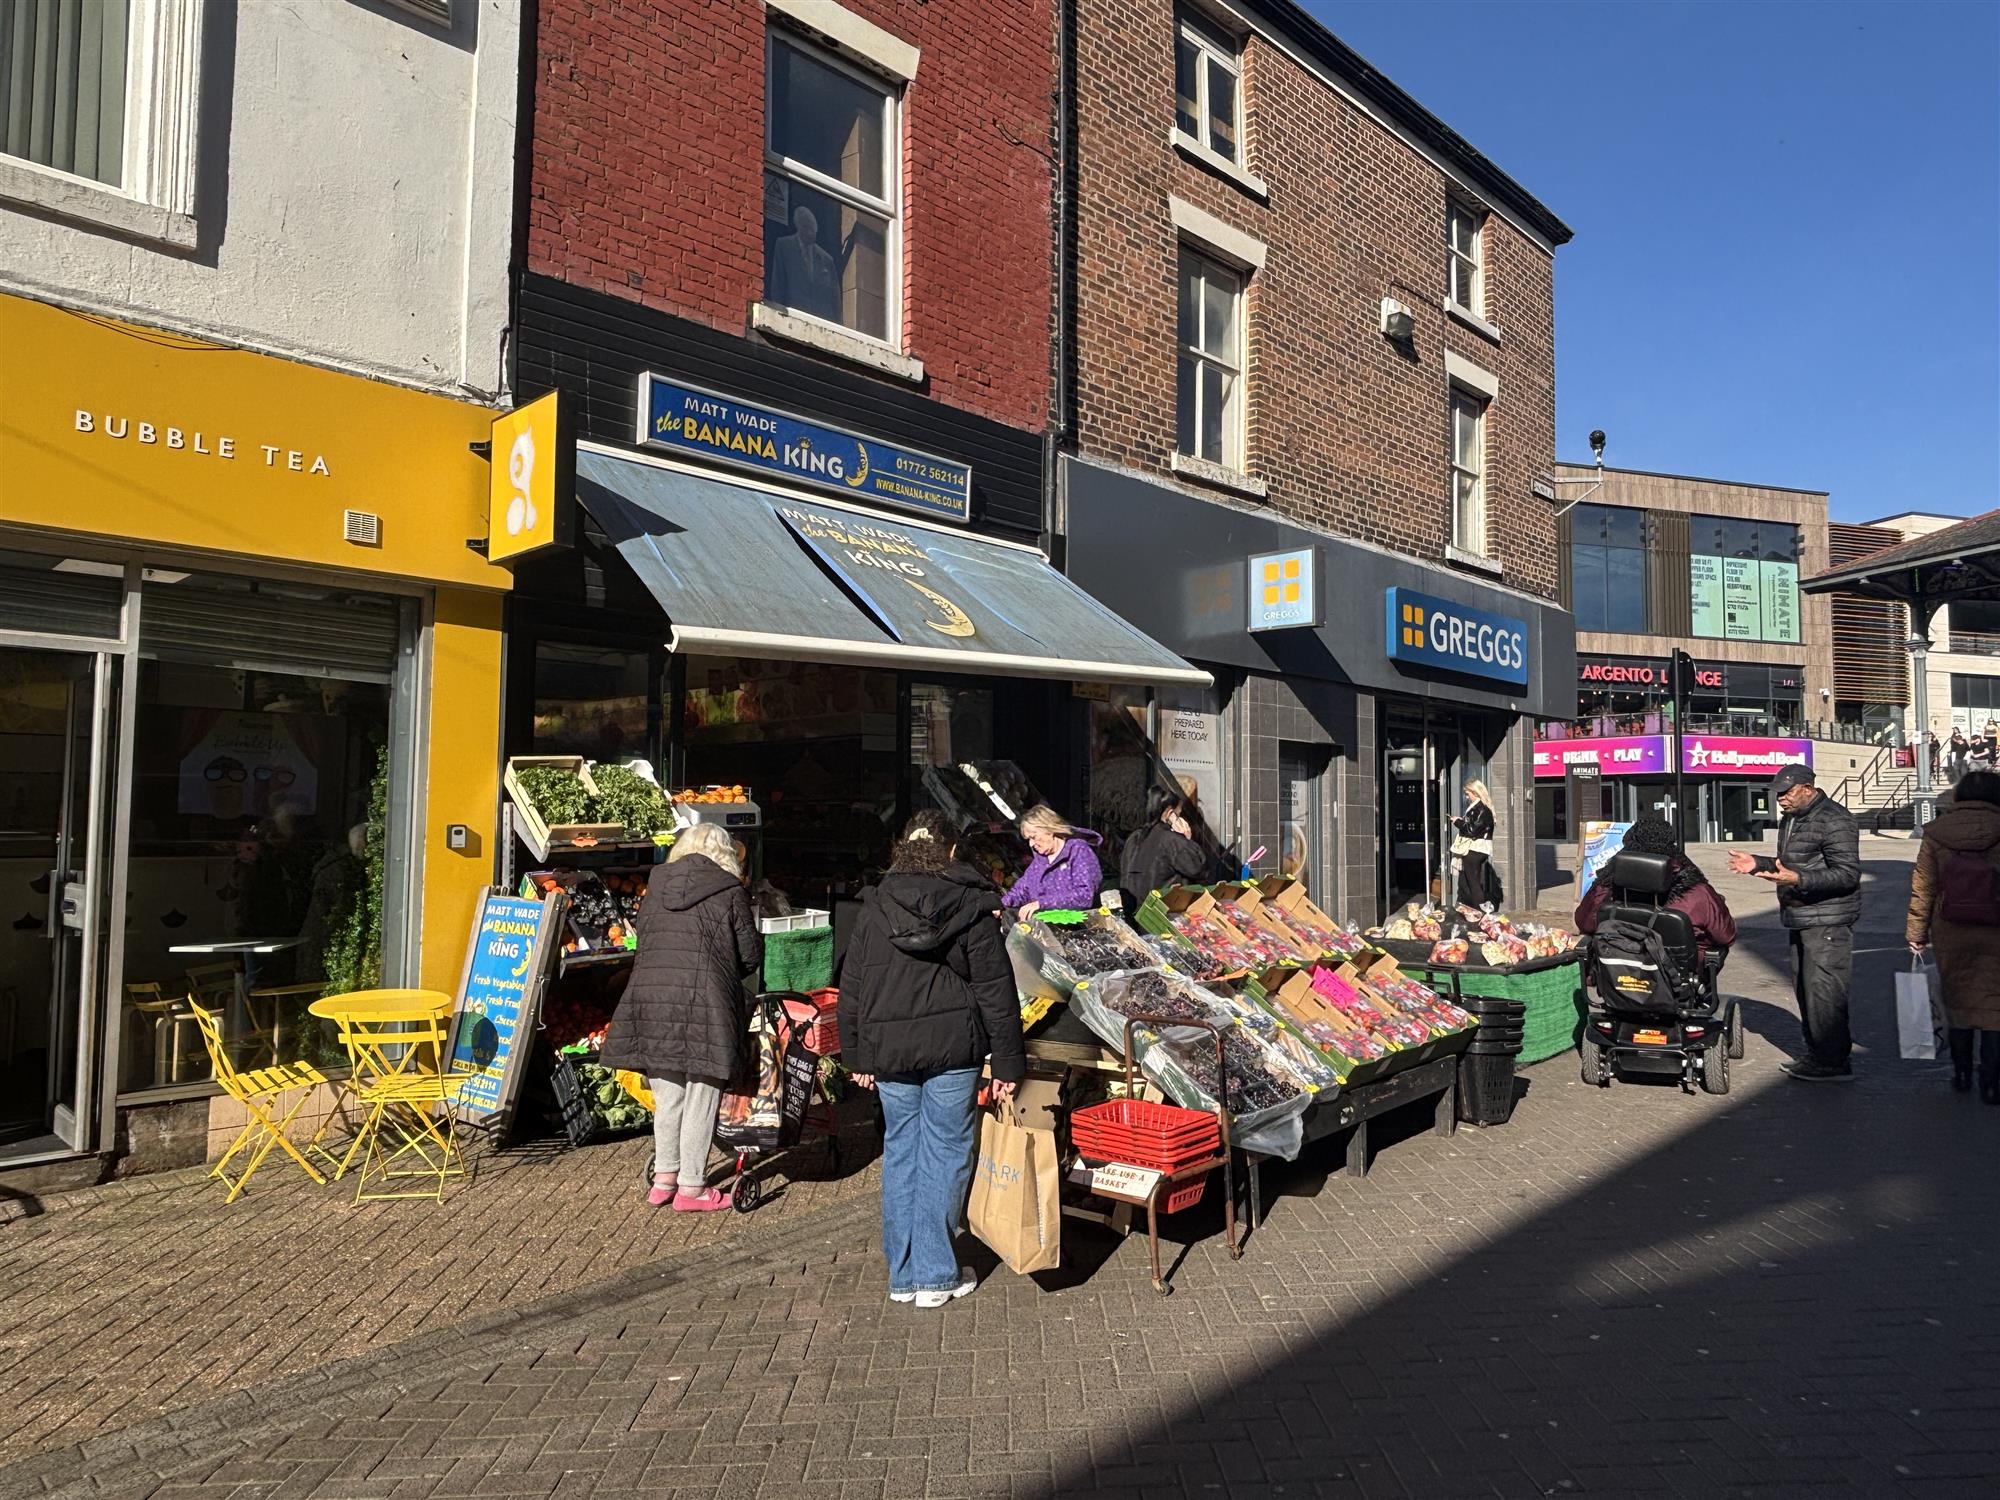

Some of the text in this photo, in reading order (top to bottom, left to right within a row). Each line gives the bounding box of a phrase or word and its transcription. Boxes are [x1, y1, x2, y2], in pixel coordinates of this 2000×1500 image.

[684, 397, 777, 434] MATT WADE
[75, 409, 331, 477] BUBBLE TEA
[656, 411, 844, 479] the BANANA KING
[896, 457, 964, 487] 01772 562114
[782, 507, 918, 547] MATT WADE
[802, 523, 934, 562] the BANANA
[844, 549, 926, 577] KING
[1777, 566, 1791, 639] ANIMATE
[1263, 609, 1300, 621] GREGGS
[1429, 611, 1522, 670] GREGGS
[1581, 665, 1722, 686] ARGENTO LNGE
[1174, 718, 1205, 729] PREPARED
[1171, 729, 1208, 741] HERE TODAY
[1563, 750, 1599, 764] DRINK
[1613, 748, 1642, 762] PLAY
[1711, 750, 1775, 768] Hollywood
[486, 905, 540, 920] MATT WADE
[493, 919, 536, 937] BANANA
[488, 941, 519, 959] KING
[1094, 1176, 1127, 1189] BASKET
